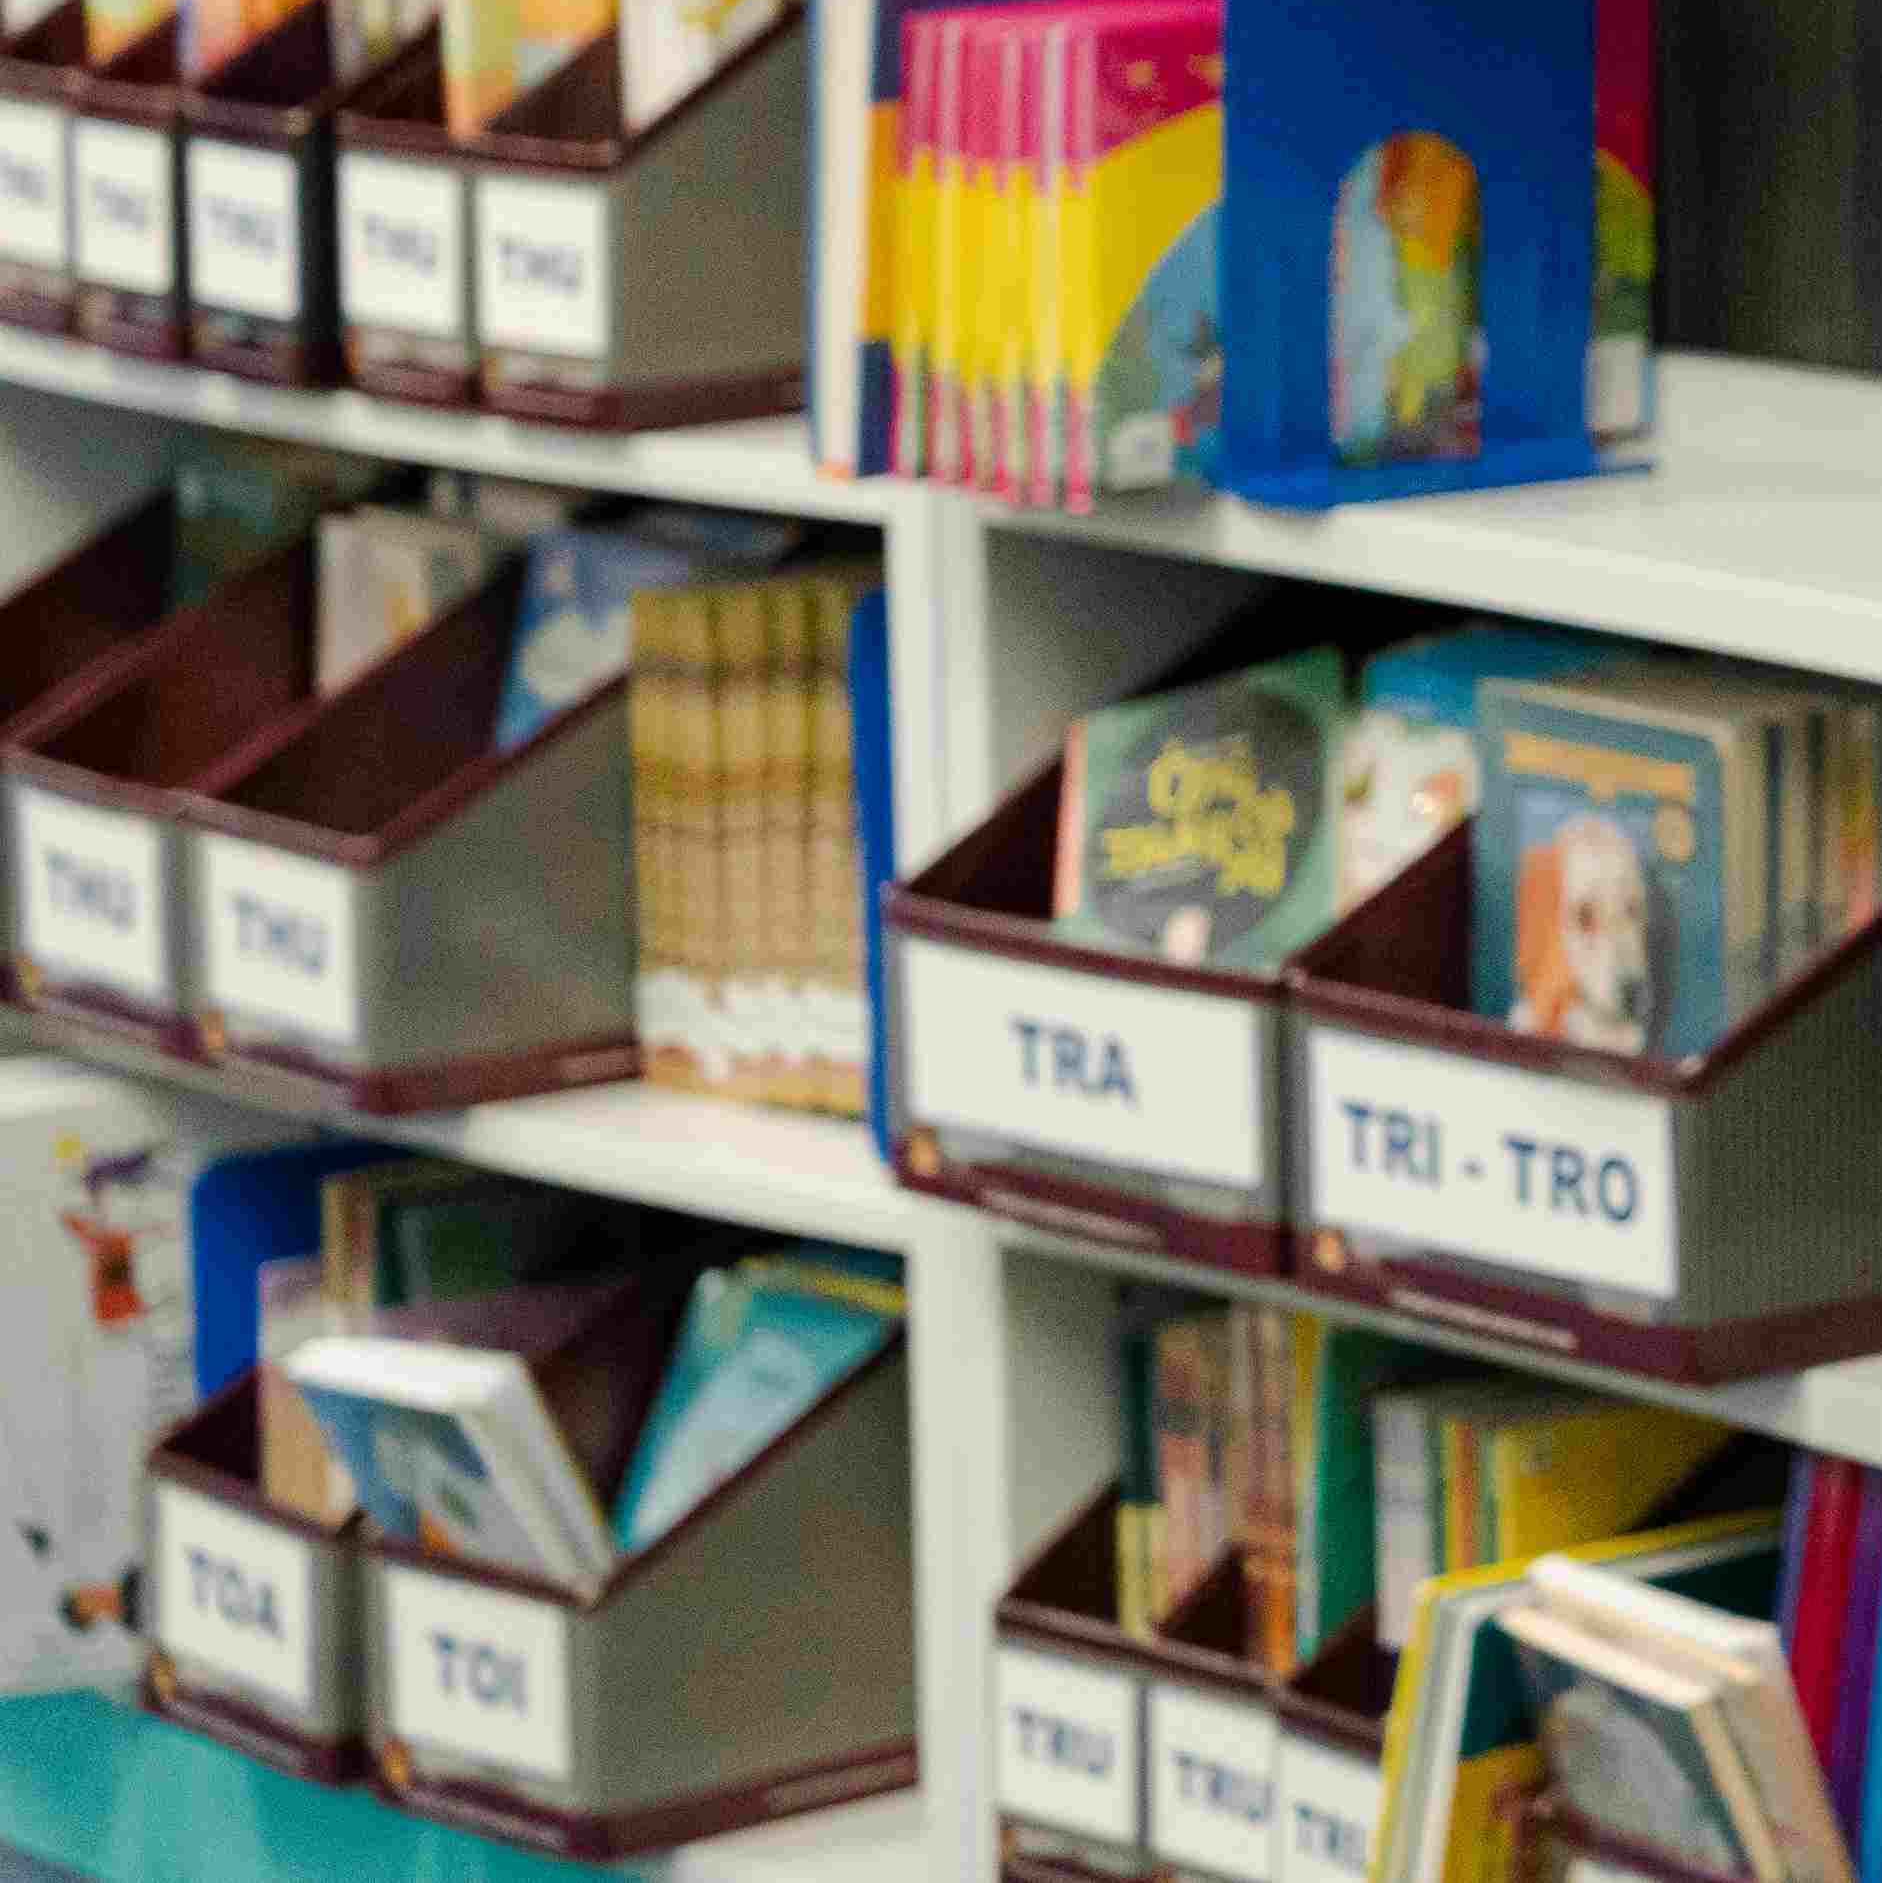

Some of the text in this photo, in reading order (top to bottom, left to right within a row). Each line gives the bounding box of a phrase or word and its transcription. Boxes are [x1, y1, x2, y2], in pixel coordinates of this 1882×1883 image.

[1014, 1020, 1134, 1100] TRA
[1342, 1101, 1439, 1181] TRI
[1505, 1136, 1638, 1224] TRO
[186, 1548, 285, 1640] TOA
[431, 1632, 526, 1710] TOI
